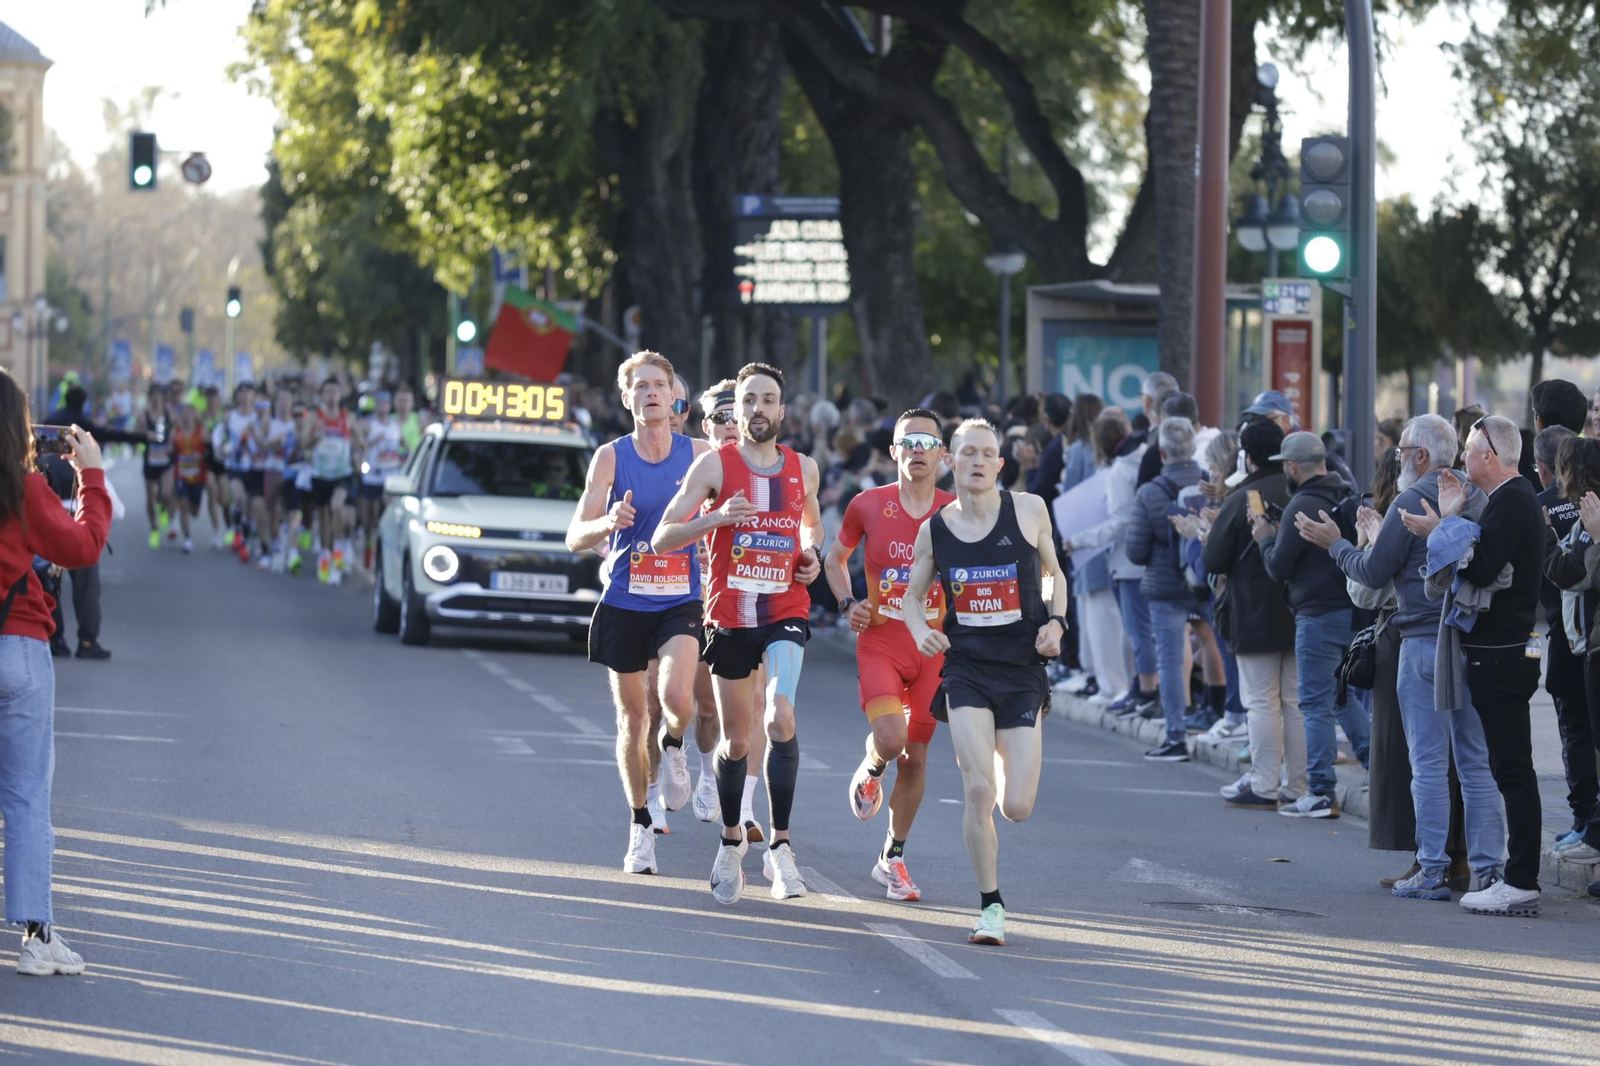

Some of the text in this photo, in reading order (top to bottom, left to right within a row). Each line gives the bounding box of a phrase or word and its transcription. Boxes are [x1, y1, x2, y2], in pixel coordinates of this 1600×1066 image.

[1548, 502, 1575, 516] AMIGOS
[1558, 509, 1581, 521] PUENT
[756, 538, 790, 548] ZURICH
[888, 541, 915, 560] ORO
[654, 559, 668, 568] 602
[756, 555, 771, 564] 545
[736, 564, 785, 581] PAQUITO
[972, 569, 1009, 579] ZURICH
[630, 574, 689, 583] DAVID BOLSCHER
[977, 587, 992, 597] 805
[970, 598, 1002, 612] RYAN
